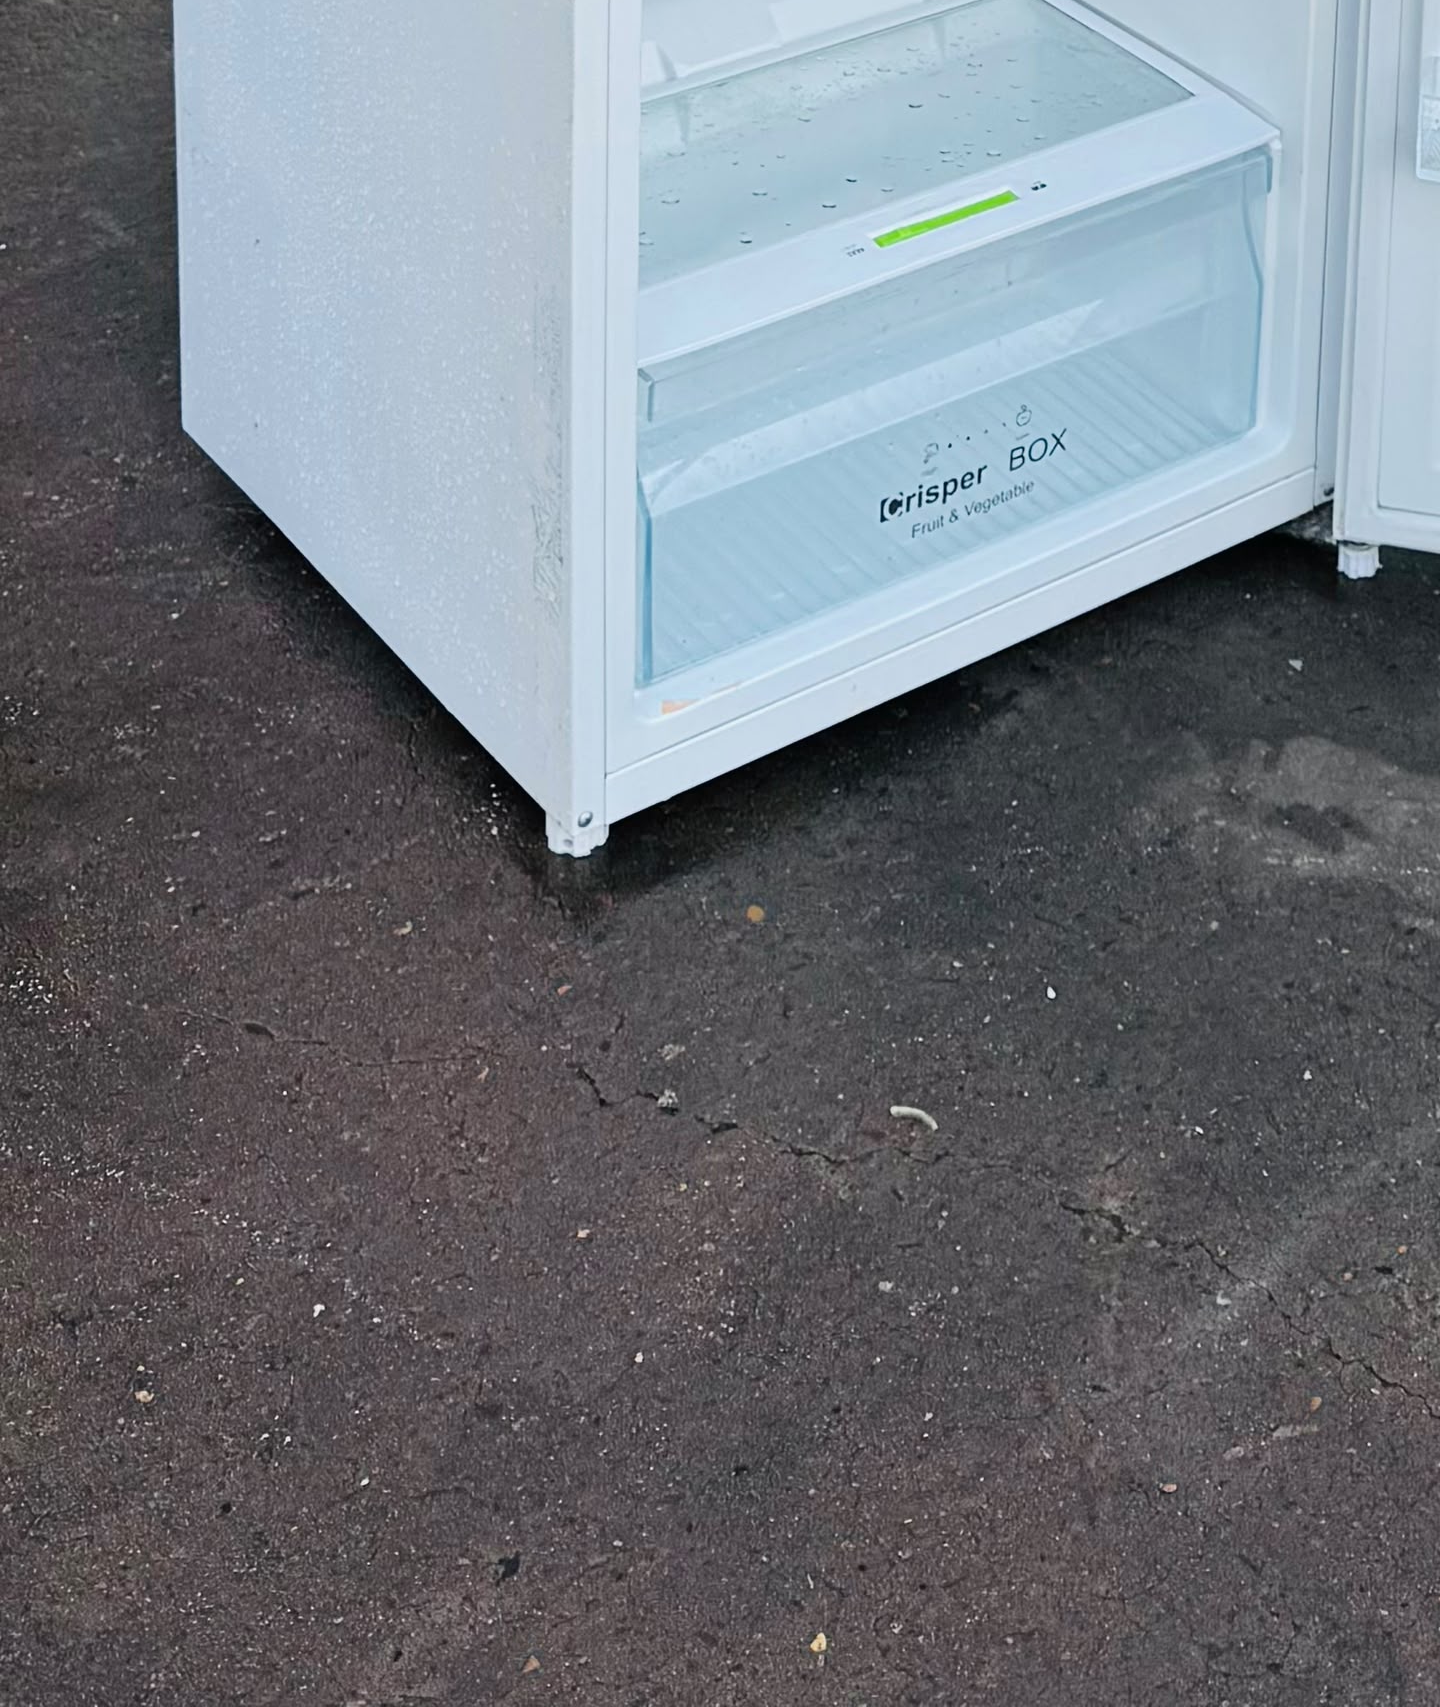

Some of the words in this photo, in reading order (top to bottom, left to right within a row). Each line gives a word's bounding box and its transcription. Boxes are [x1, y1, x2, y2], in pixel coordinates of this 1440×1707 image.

[879, 464, 988, 523] Crisper
[1009, 428, 1068, 472] BOX
[911, 515, 945, 539] Fruit
[948, 508, 960, 524] &
[964, 480, 1035, 517] Vegetable
